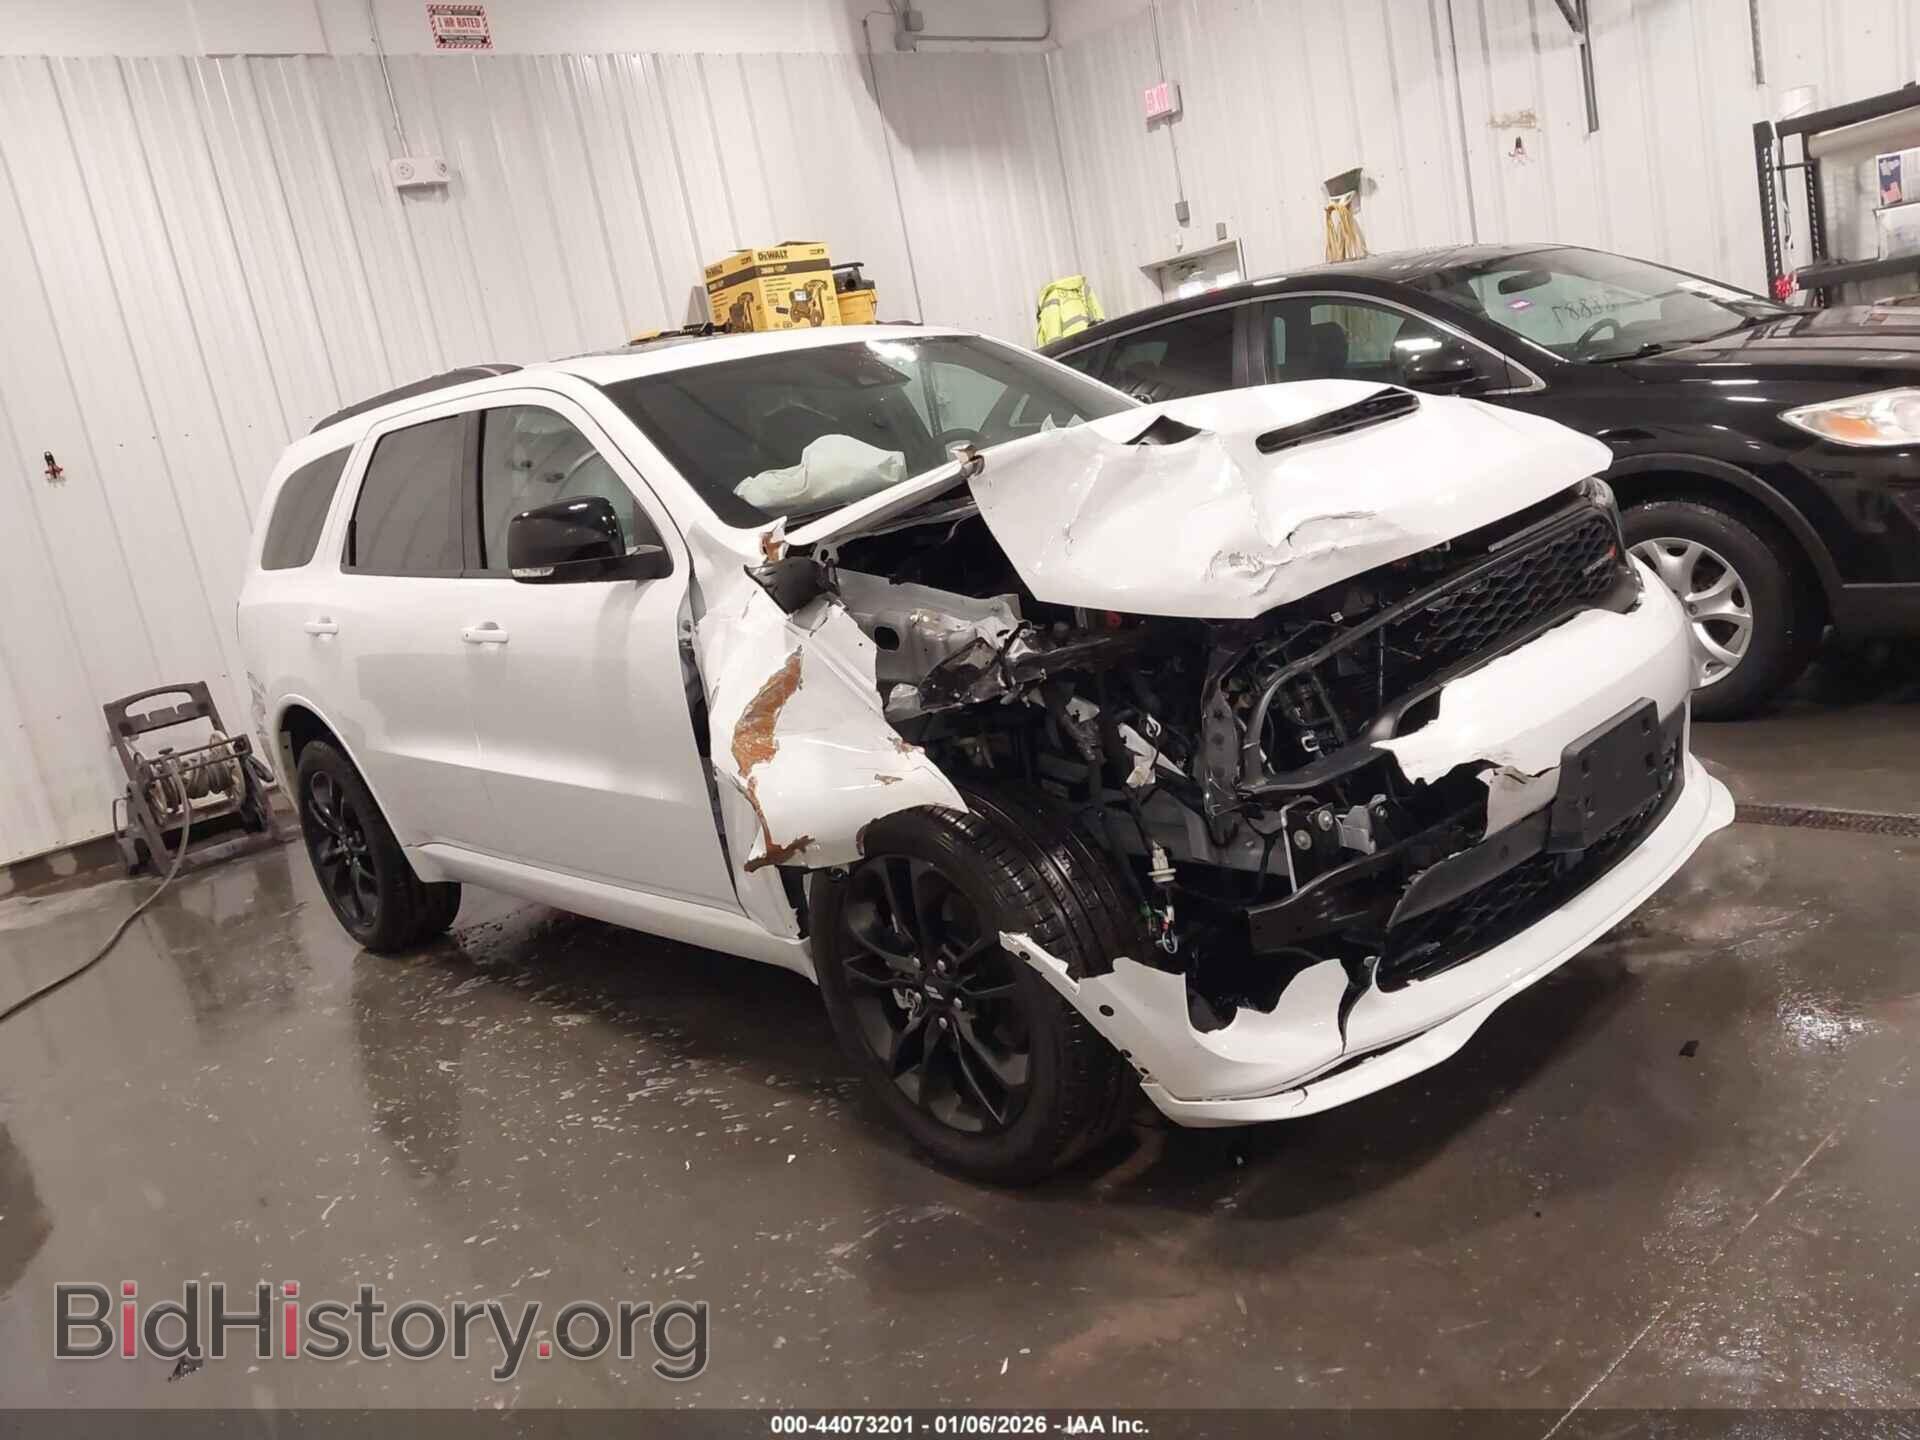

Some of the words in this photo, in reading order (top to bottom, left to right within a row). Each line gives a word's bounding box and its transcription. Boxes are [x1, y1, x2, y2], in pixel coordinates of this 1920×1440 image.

[443, 17, 455, 27] HR
[456, 17, 481, 28] RATED
[1144, 84, 1168, 113] EXIT
